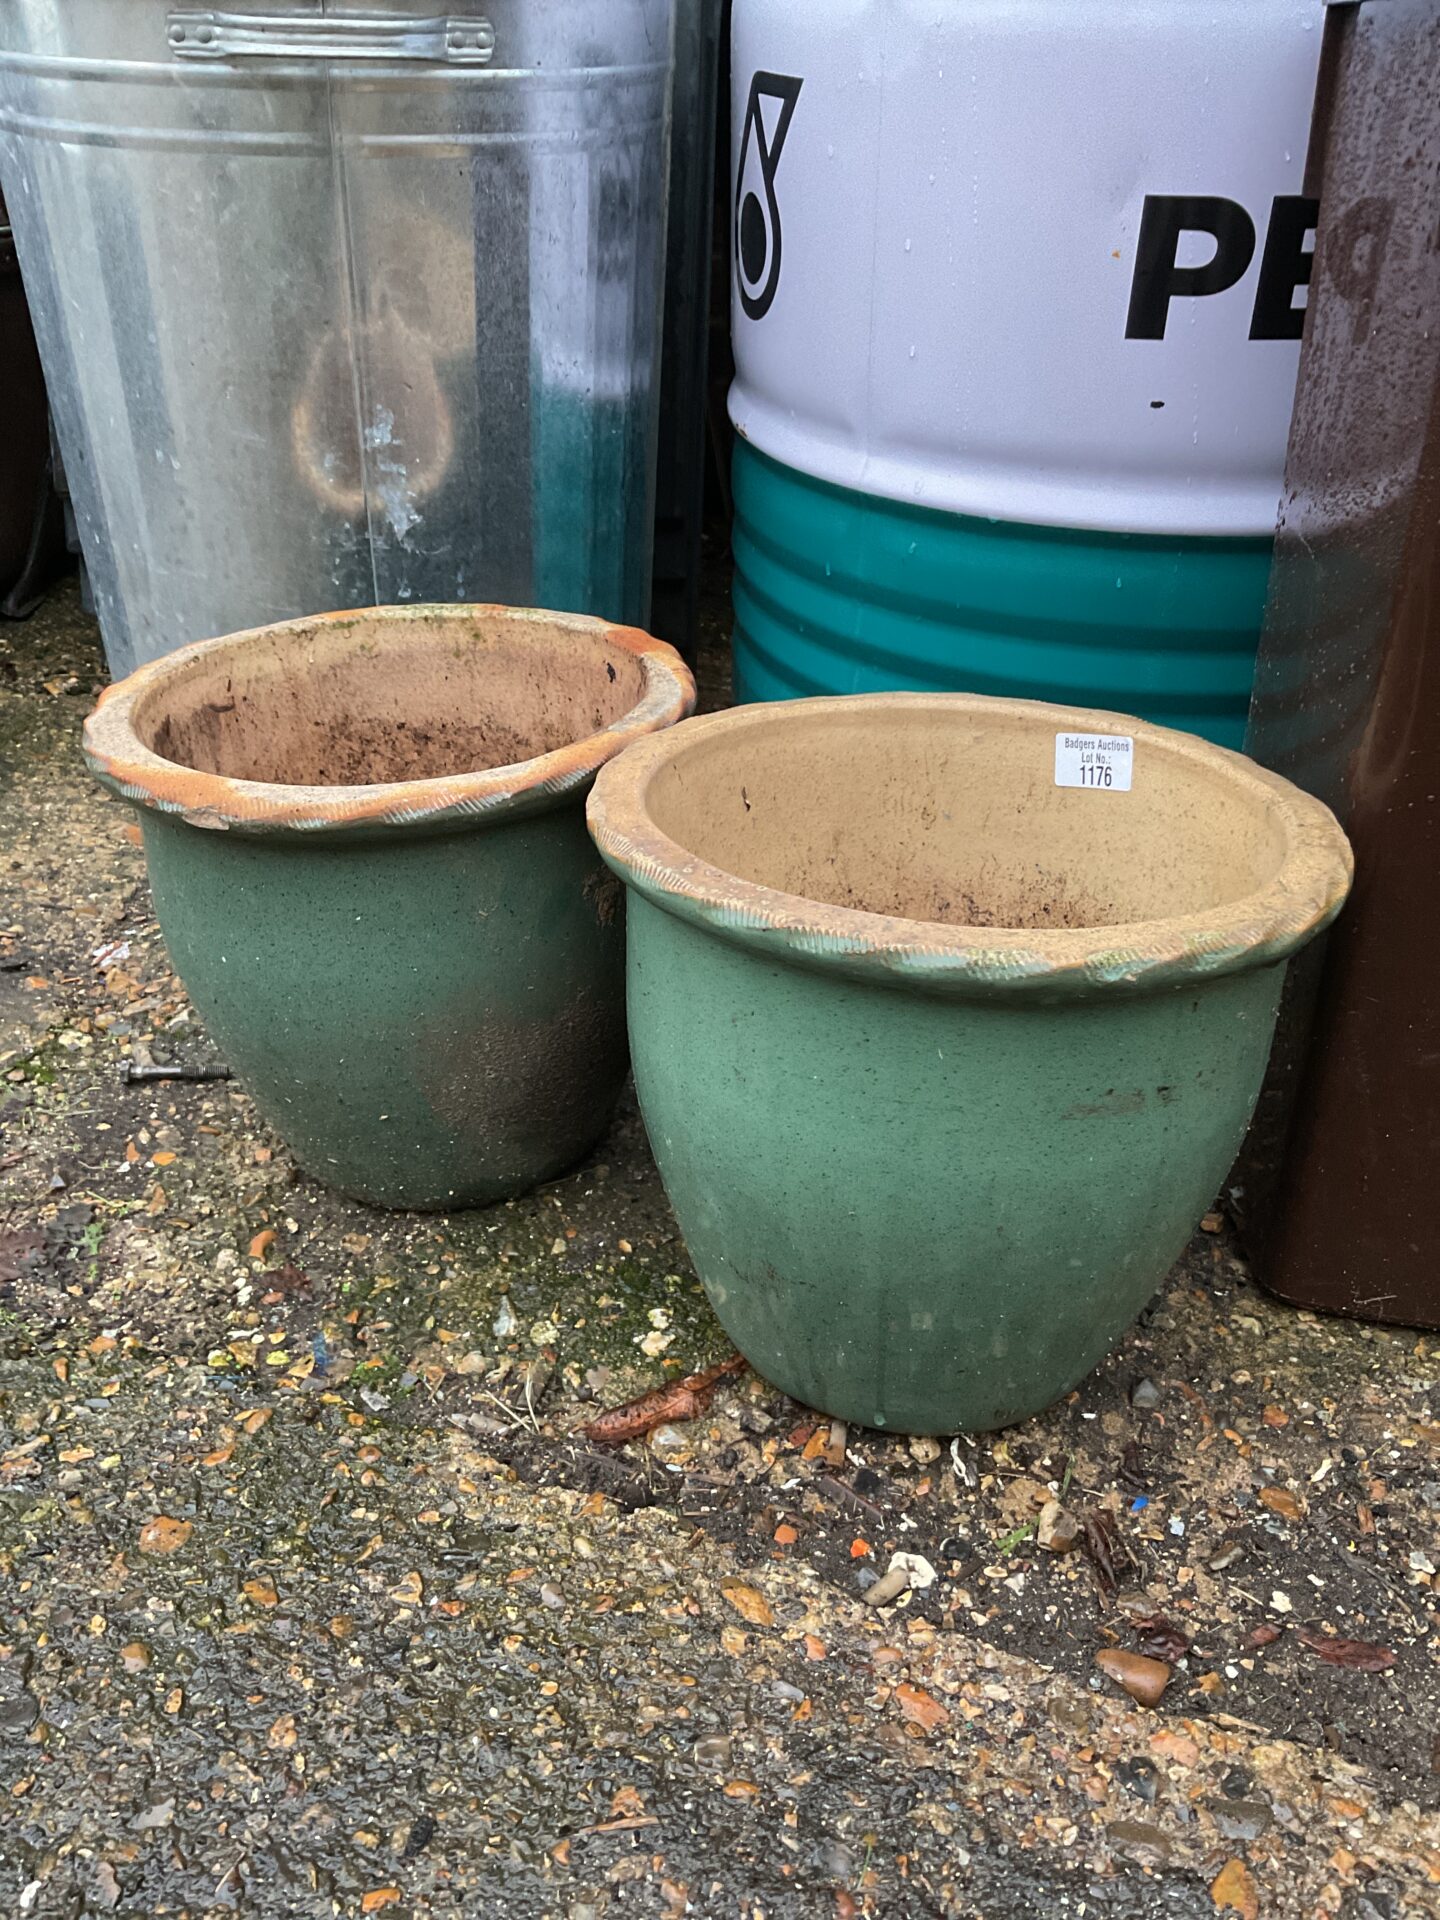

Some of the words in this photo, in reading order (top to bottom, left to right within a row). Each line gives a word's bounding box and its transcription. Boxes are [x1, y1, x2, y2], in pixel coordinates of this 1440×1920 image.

[1064, 737, 1095, 751] Badgers
[1097, 739, 1130, 752] Auctions
[1081, 752, 1093, 764] Lot
[1079, 764, 1112, 787] 1176
